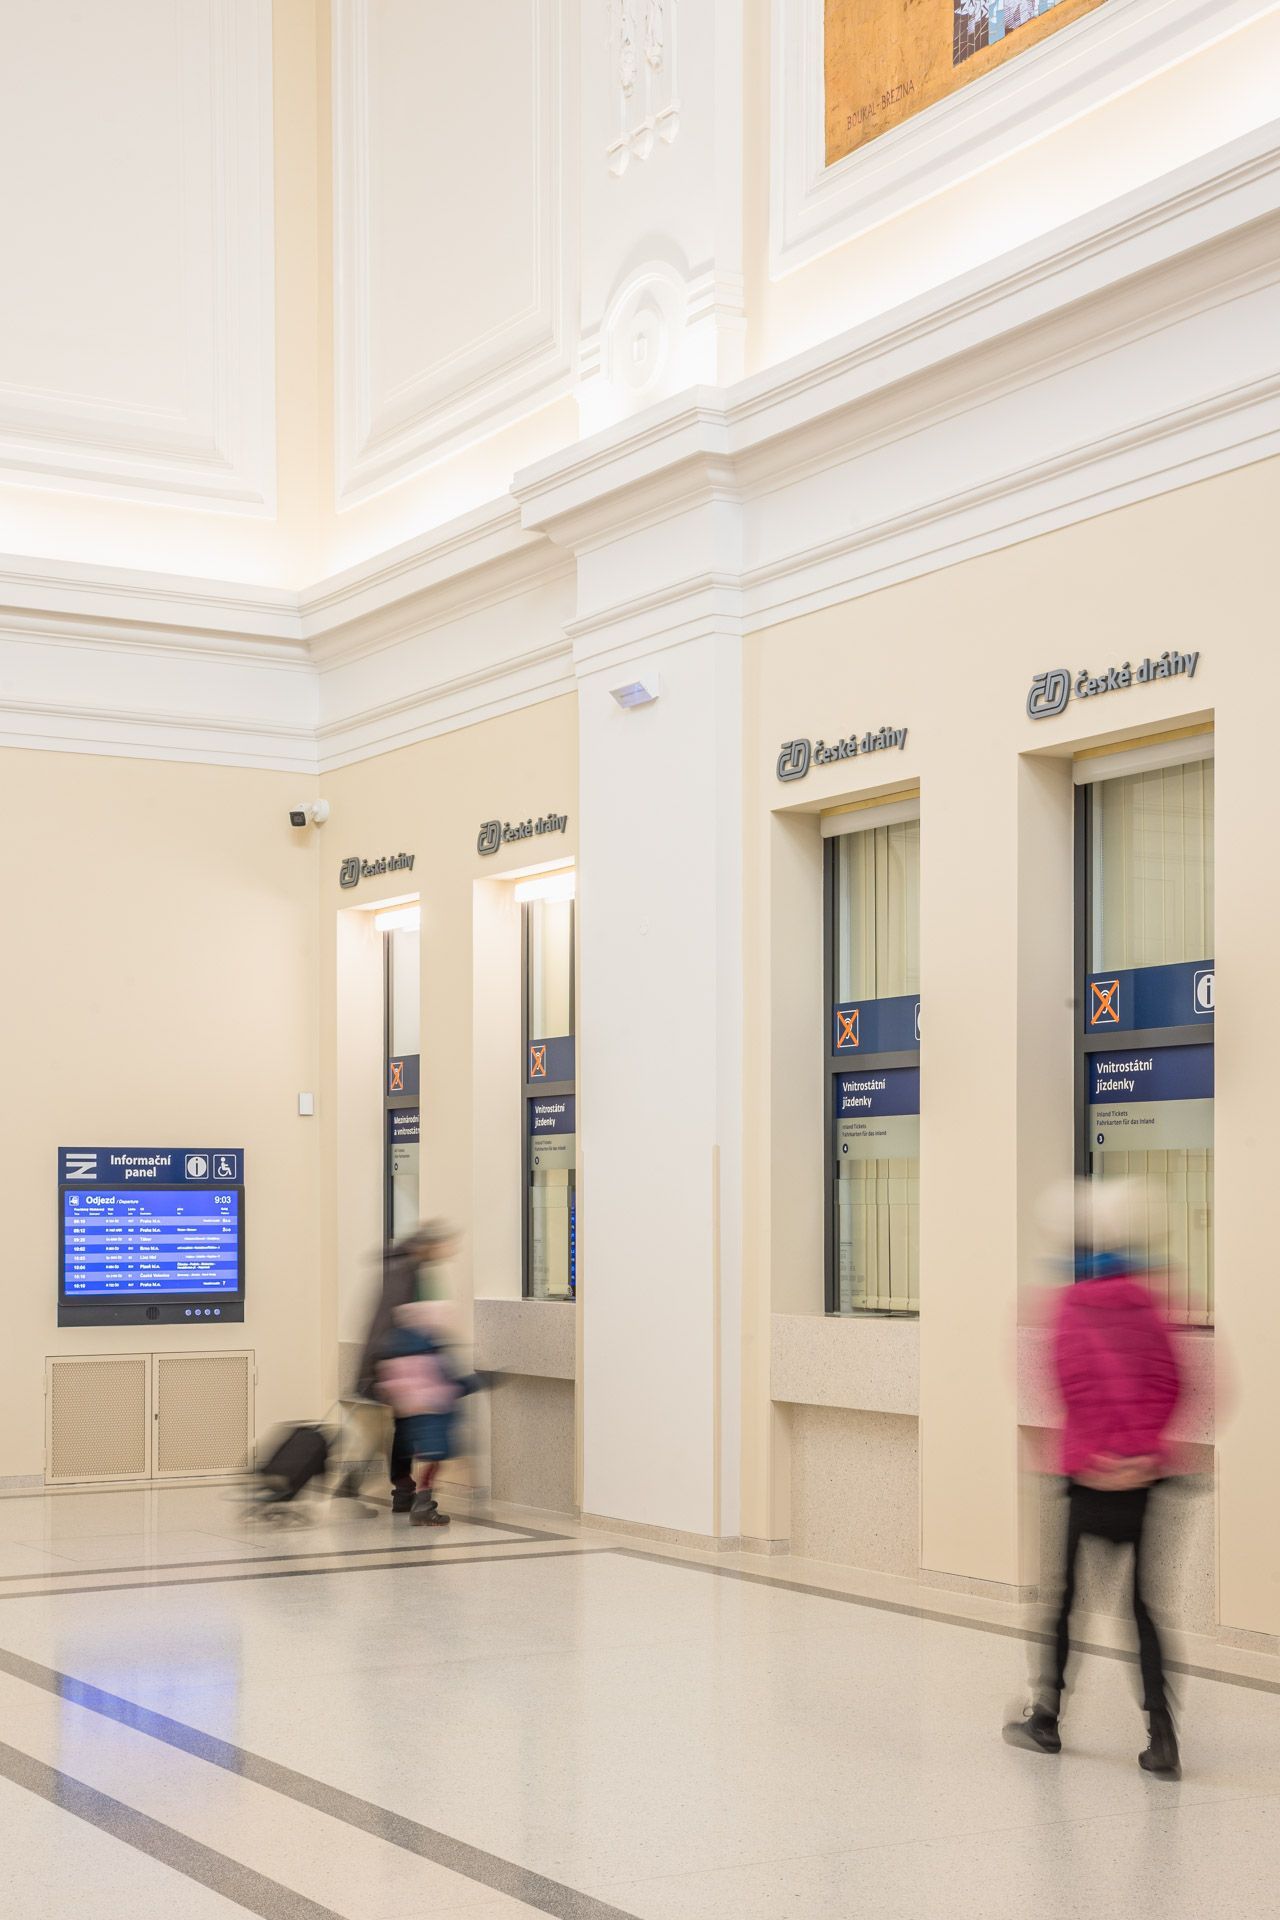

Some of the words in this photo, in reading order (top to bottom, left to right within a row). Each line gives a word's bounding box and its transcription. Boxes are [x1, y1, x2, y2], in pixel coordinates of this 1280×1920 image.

[1074, 661, 1132, 699] České
[1136, 651, 1200, 682] dráhy
[813, 734, 858, 765] České
[860, 726, 908, 753] dráhy
[502, 818, 533, 843] České
[535, 813, 568, 834] dráhy
[361, 856, 386, 878] České
[387, 852, 415, 872] dráhy
[1096, 1058, 1153, 1074] Vnitrostátní
[842, 1079, 886, 1092] Vnitrostátní
[1096, 1078, 1135, 1094] jízdenky
[534, 1102, 566, 1114] Vnitrostátní
[842, 1096, 872, 1109] jízdenky
[534, 1117, 556, 1129] jízdenky
[110, 1155, 171, 1166] Informační
[125, 1167, 157, 1179] panel
[86, 1196, 115, 1205] Odjezd
[214, 1196, 231, 1204] 9:03
